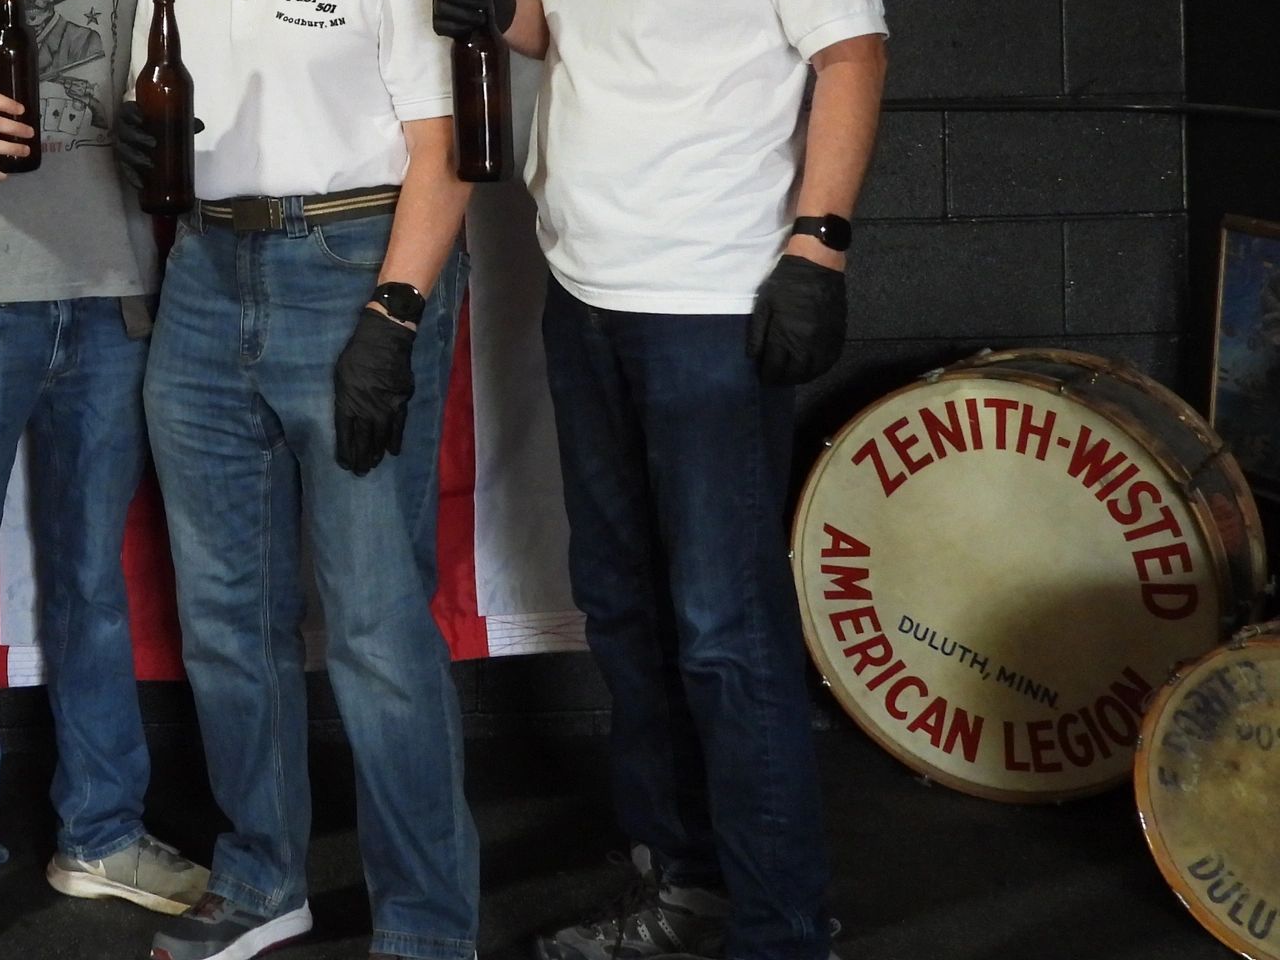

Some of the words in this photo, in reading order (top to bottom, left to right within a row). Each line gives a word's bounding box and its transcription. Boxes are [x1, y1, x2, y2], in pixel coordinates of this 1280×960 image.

[315, 2, 337, 14] 501
[330, 17, 346, 27] MN
[851, 398, 1199, 620] ZENITH-WISTED
[820, 522, 984, 763] AMERICAN
[1003, 666, 1154, 773] LEGION
[898, 614, 991, 681] DULUTH,
[996, 666, 1059, 710] MINN.
